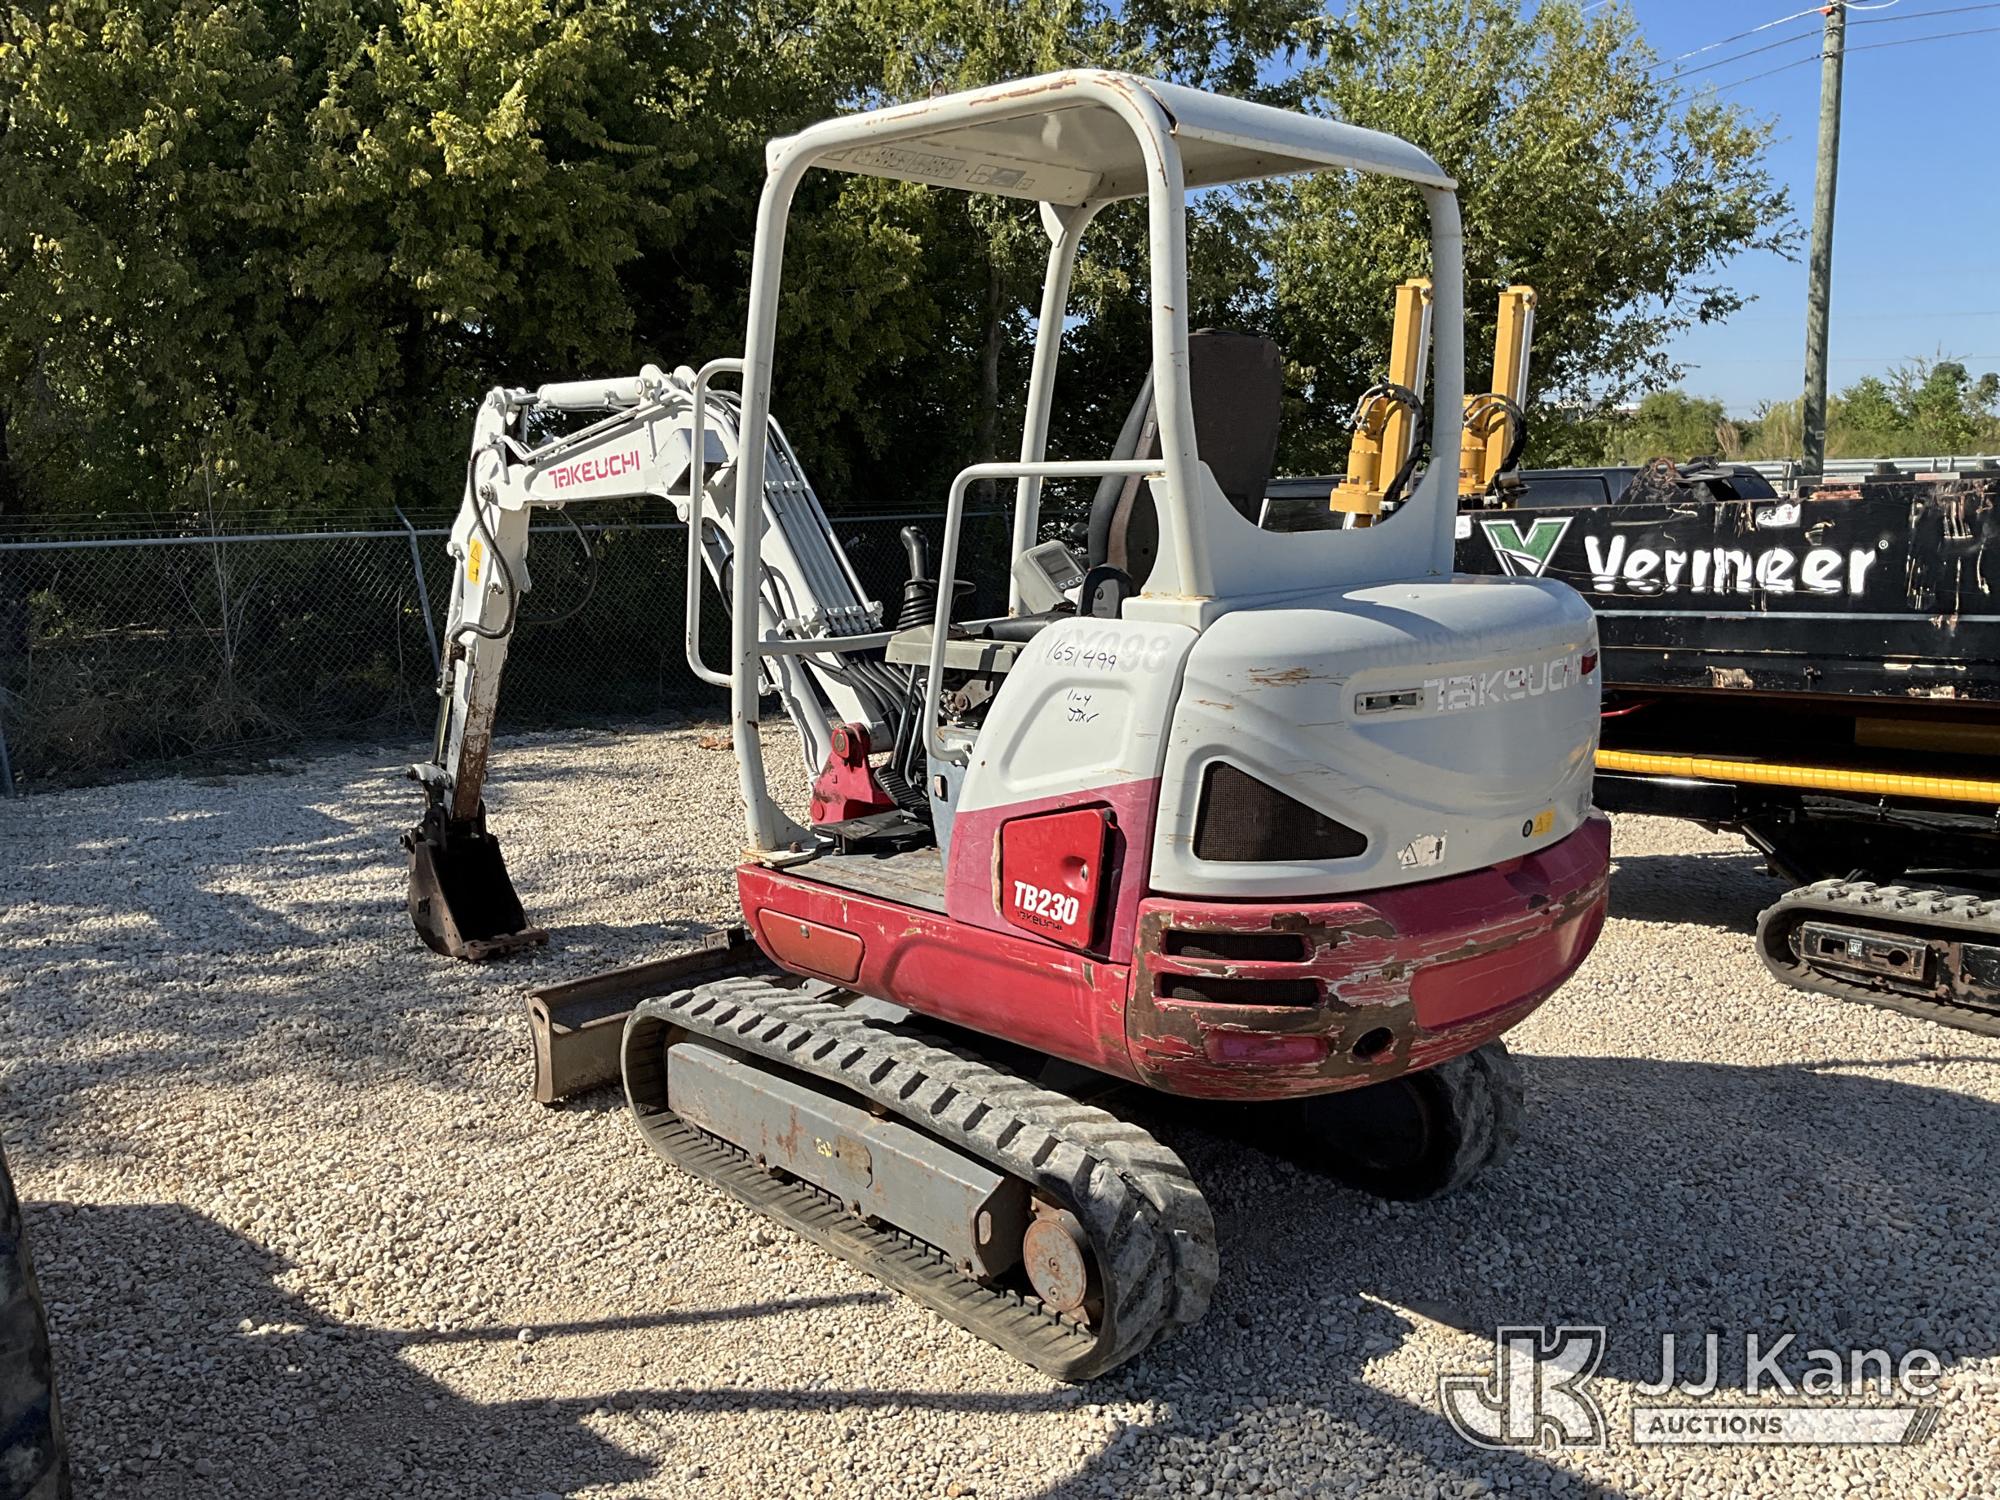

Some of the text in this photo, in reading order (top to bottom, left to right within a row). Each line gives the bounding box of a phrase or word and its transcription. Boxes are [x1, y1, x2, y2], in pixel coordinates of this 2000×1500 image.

[548, 450, 641, 489] TAKEUCHI
[1584, 534, 1877, 595] Vermeer
[1046, 640, 1117, 671] 1651499
[1014, 880, 1079, 926] TB230
